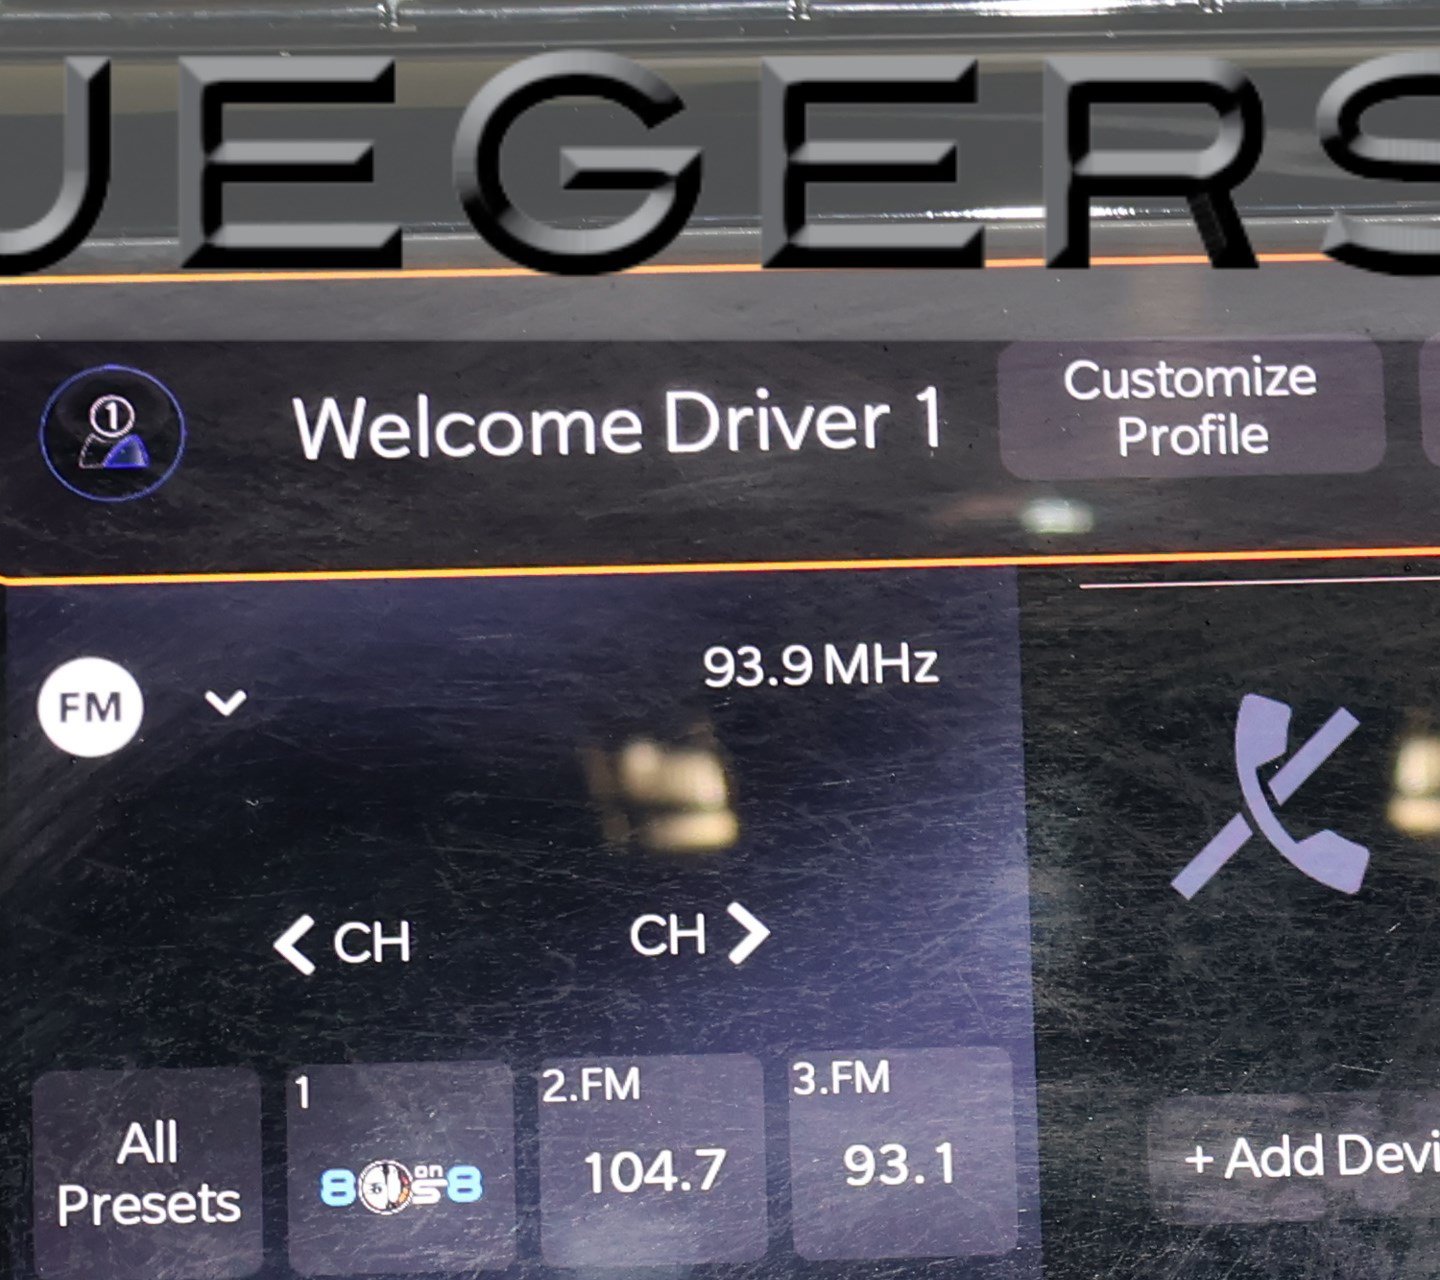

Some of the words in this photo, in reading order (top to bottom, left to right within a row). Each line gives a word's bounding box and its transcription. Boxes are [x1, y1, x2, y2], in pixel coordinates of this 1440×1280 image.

[1064, 354, 1317, 400] Customize
[104, 400, 119, 432] 1
[292, 393, 643, 460] Welcome
[666, 387, 891, 453] Driver
[916, 386, 939, 448] 1
[1118, 412, 1269, 457] Profile
[704, 644, 813, 688] 93.9
[824, 641, 940, 685] MHz
[61, 691, 120, 722] FM
[334, 920, 410, 964] CH
[630, 913, 706, 956] CH
[293, 1074, 310, 1110] 1
[542, 1066, 640, 1103] 2.FM
[793, 1059, 890, 1095] 3.FM
[116, 1119, 177, 1165] All
[844, 1142, 952, 1186] 93.1
[1224, 1132, 1324, 1179] Add
[584, 1148, 727, 1194] 104.7
[58, 1183, 241, 1227] Presets
